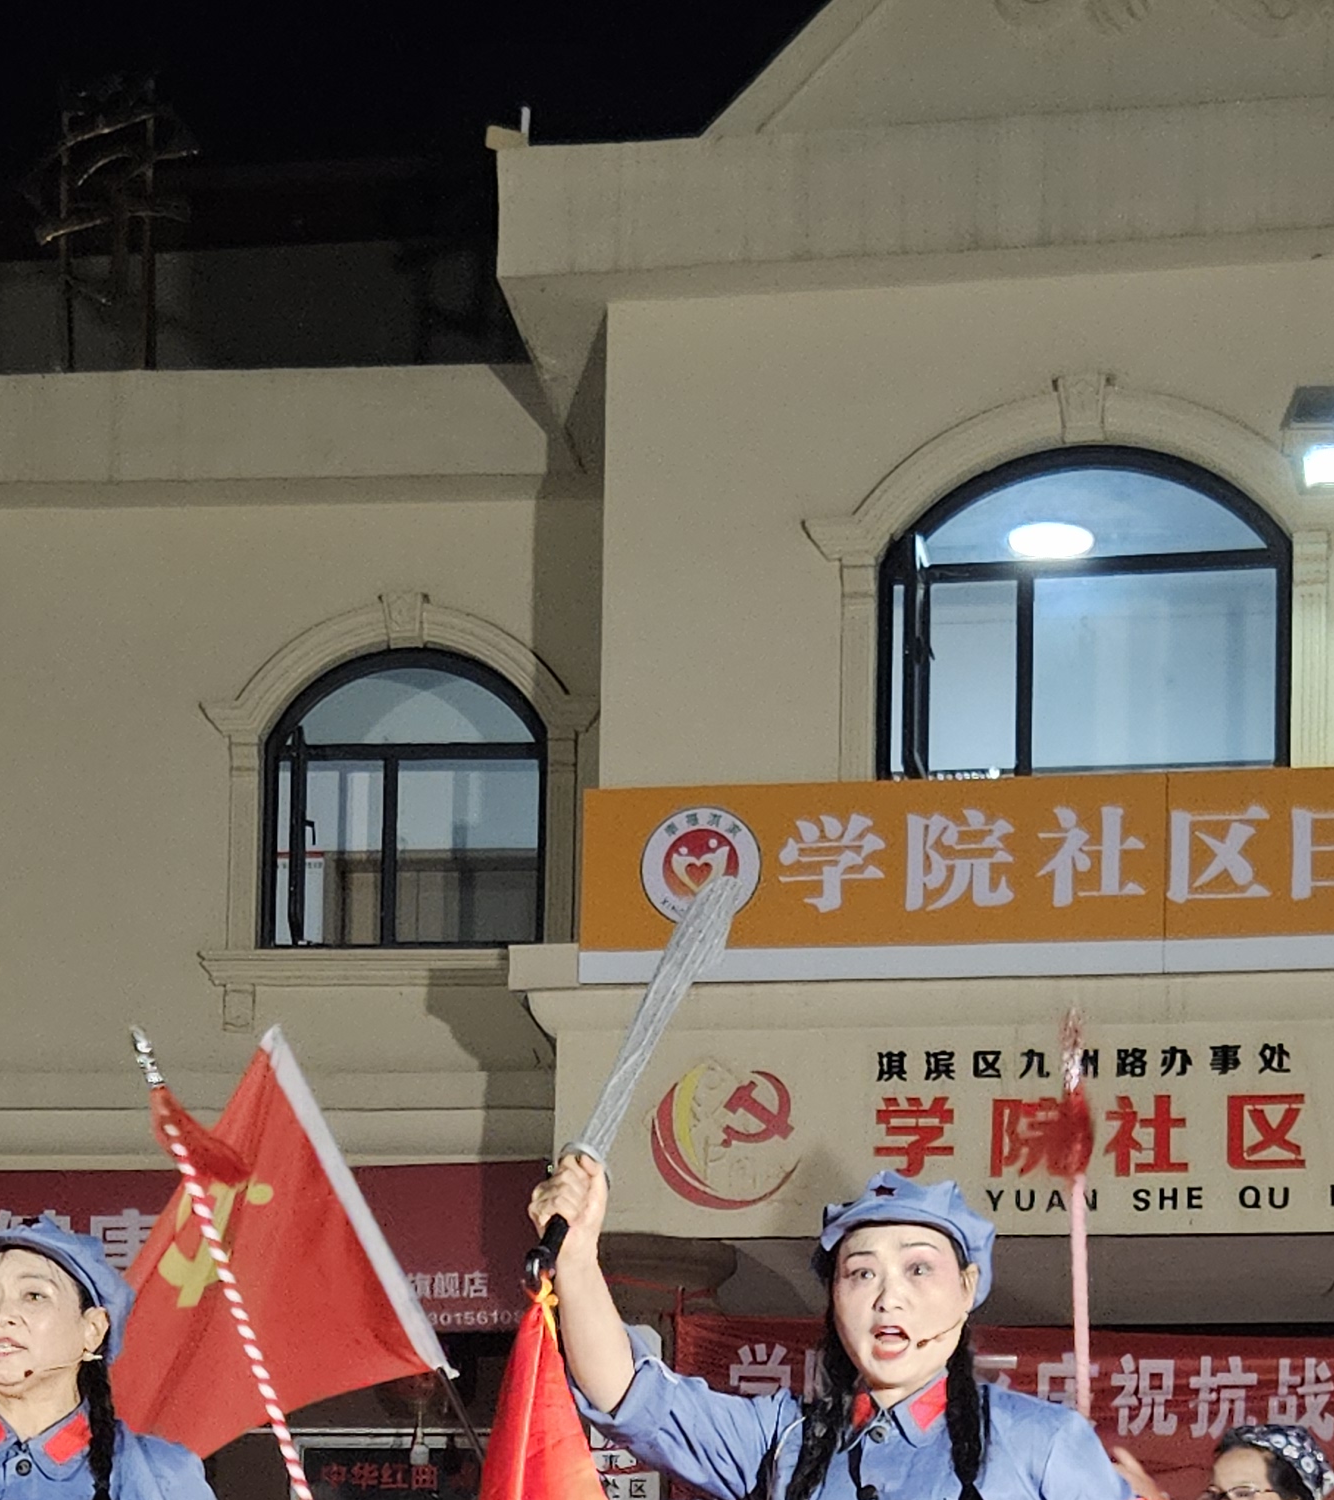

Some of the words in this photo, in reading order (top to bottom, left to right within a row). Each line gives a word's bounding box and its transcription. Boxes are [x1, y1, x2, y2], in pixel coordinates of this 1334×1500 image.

[985, 1189, 1098, 1212] YUAN
[1132, 1186, 1204, 1211] SHE
[1238, 1185, 1291, 1210] QU
